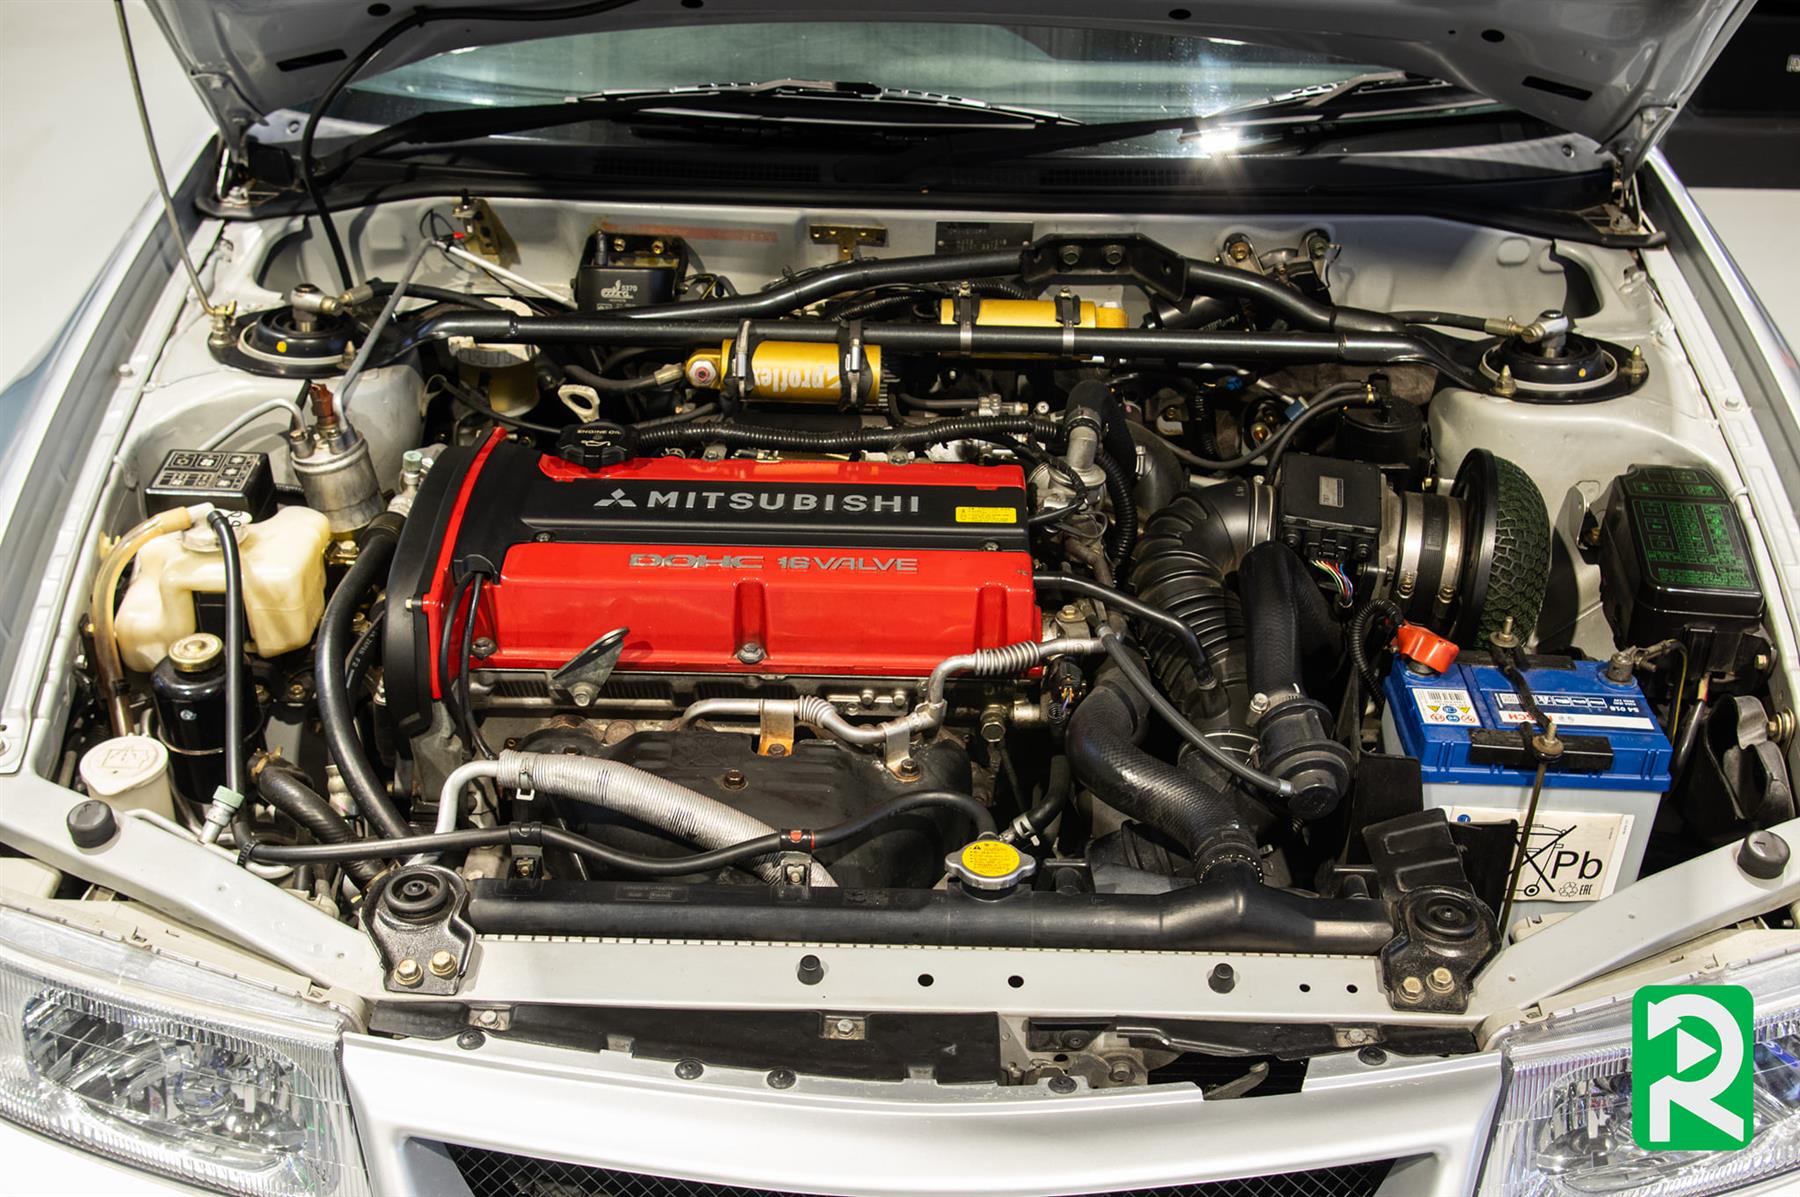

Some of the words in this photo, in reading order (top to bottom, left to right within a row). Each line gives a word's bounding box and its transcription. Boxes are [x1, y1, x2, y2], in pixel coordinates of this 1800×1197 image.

[647, 490, 920, 513] MITSUBISHI
[629, 553, 765, 569] DOHC
[1551, 850, 1603, 879] Pb
